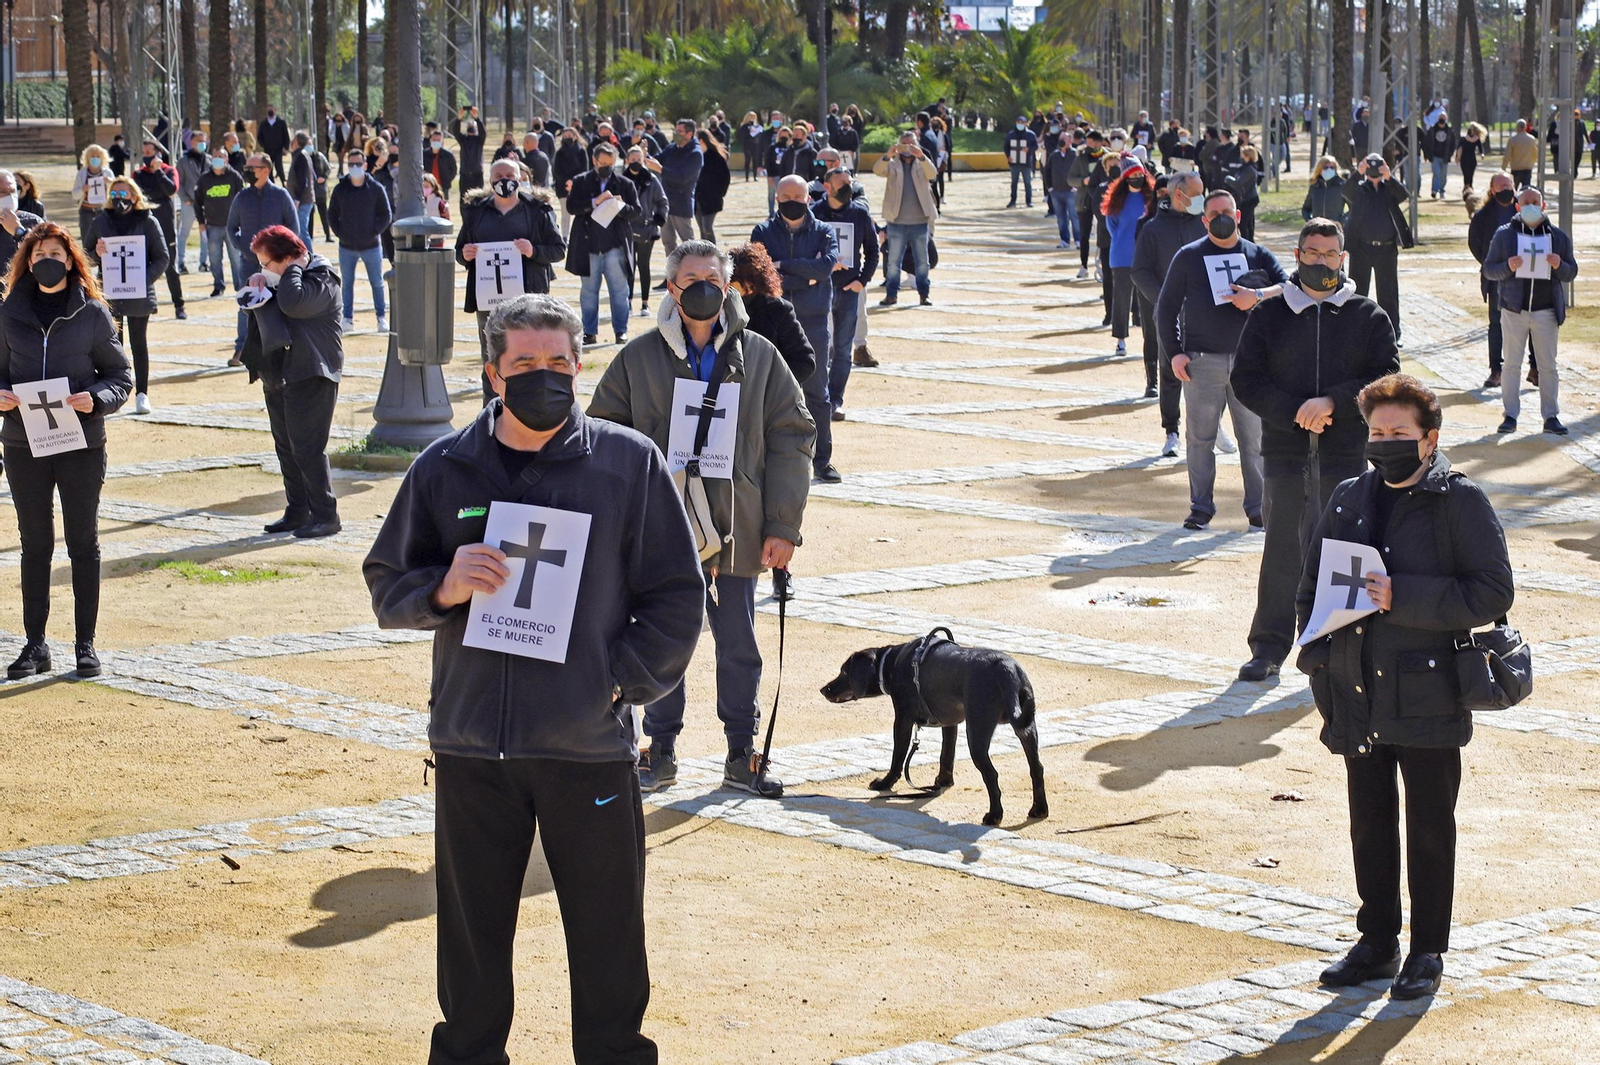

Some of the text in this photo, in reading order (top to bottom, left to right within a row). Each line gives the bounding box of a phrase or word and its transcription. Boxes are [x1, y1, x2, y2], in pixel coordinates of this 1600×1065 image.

[45, 436, 79, 448] AUTONOMO
[47, 430, 80, 441] DESCANSA
[481, 613, 557, 635] EL COMERCIO
[487, 627, 544, 646] SE MUERE
